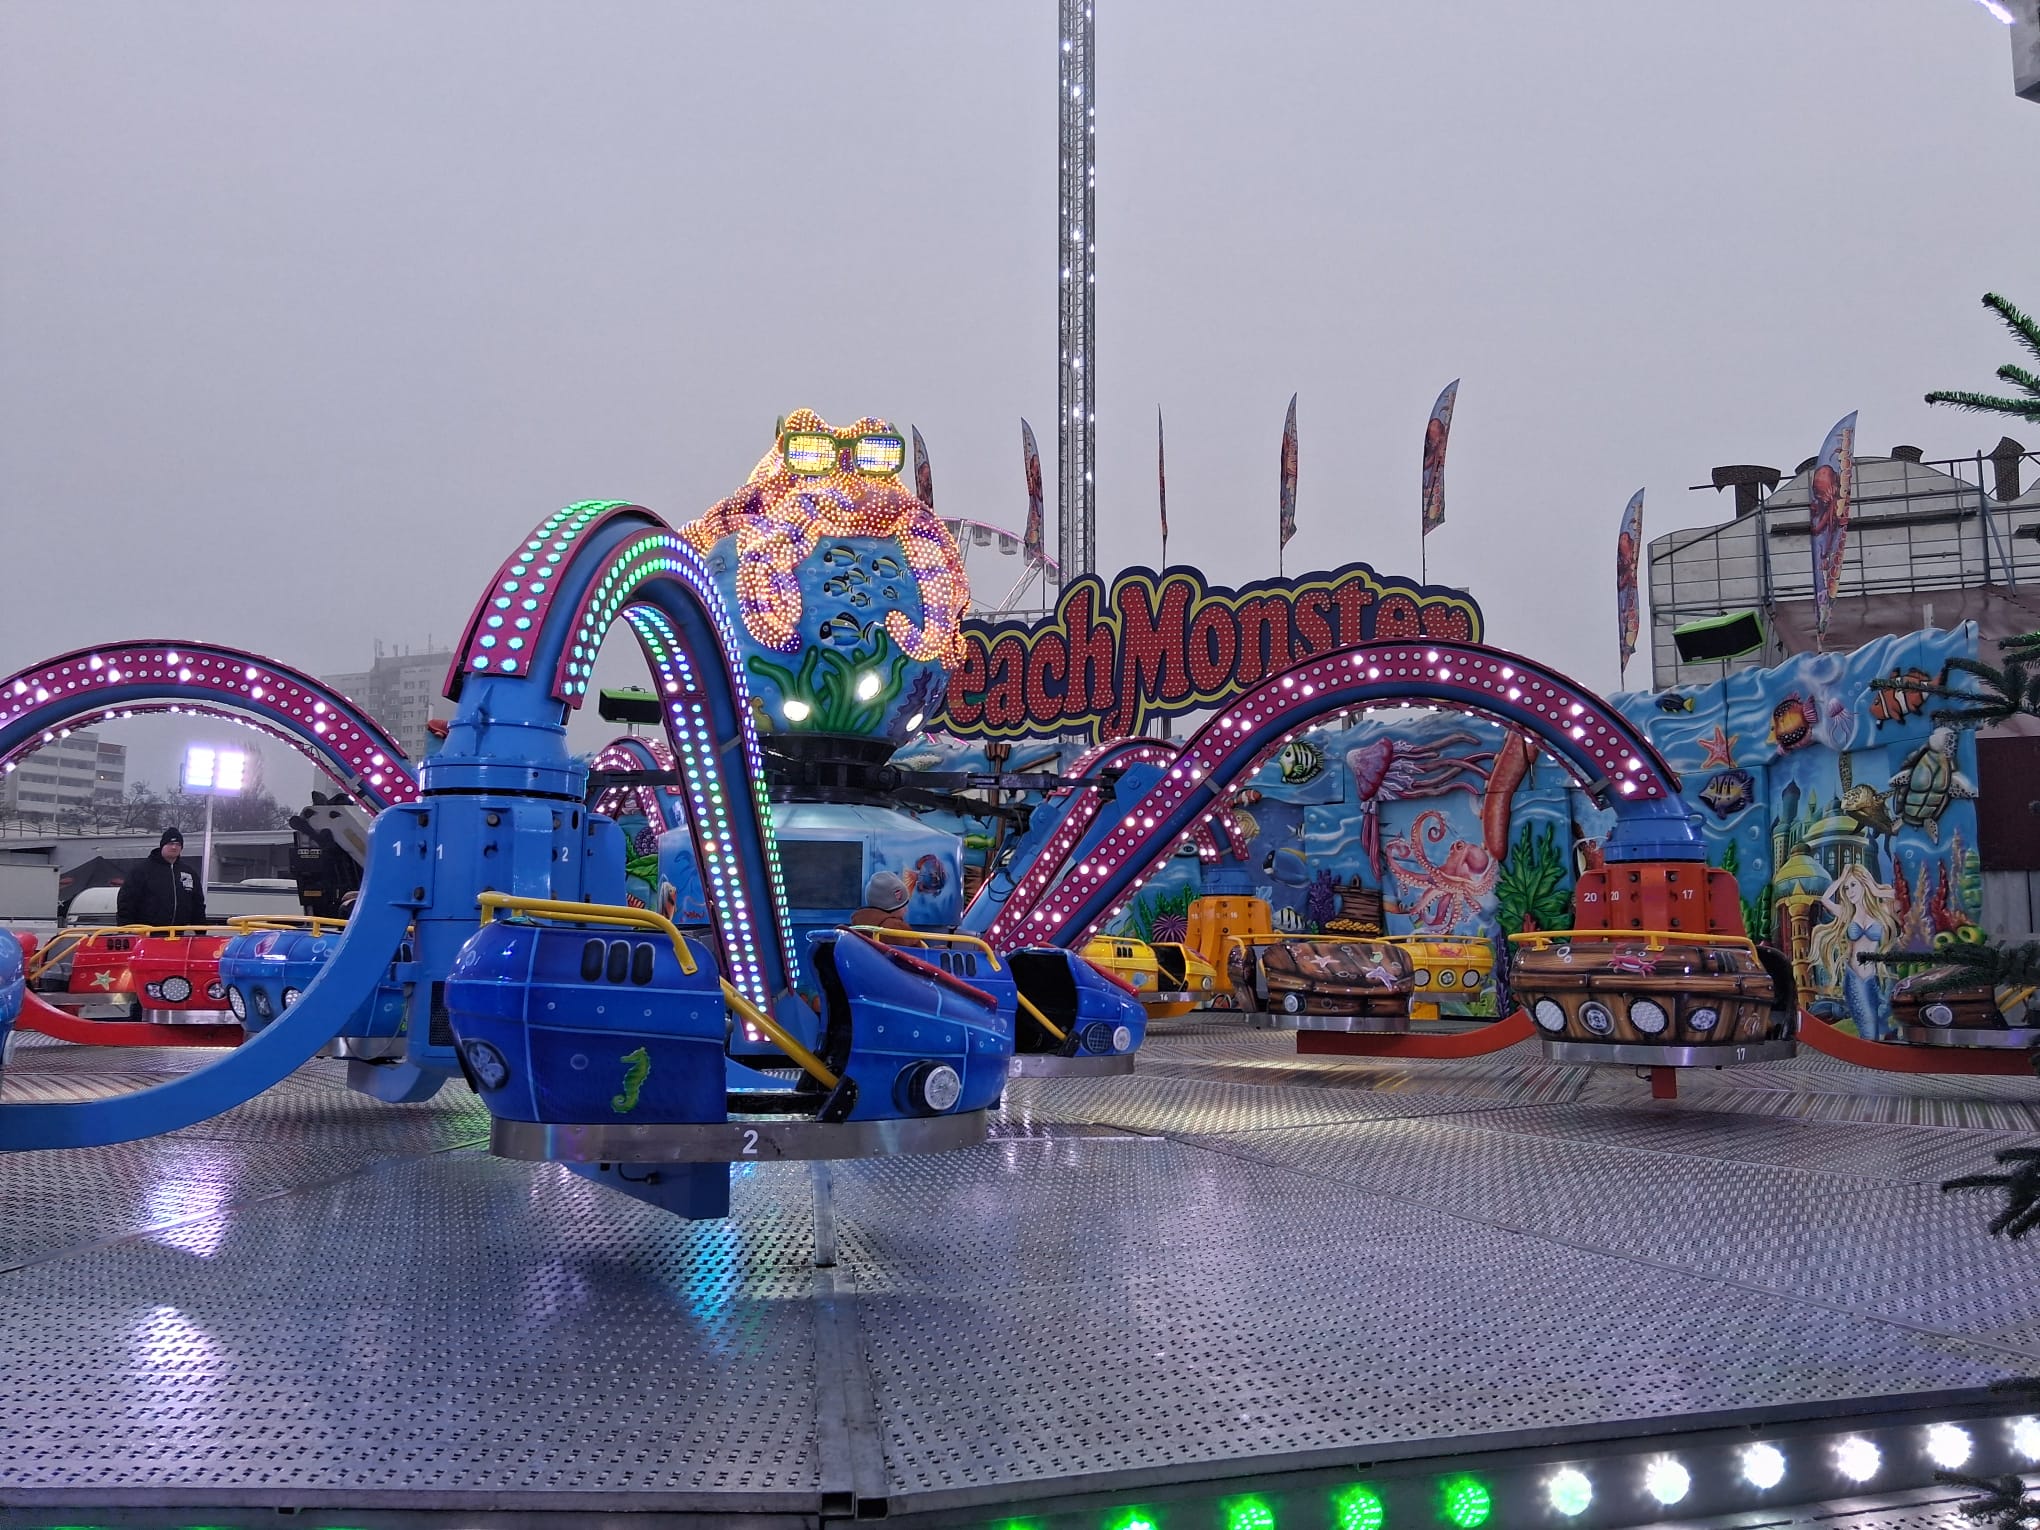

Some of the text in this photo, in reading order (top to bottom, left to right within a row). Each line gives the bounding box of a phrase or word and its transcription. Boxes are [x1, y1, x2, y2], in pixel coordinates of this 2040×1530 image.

[392, 840, 402, 857] 1
[436, 843, 444, 860] 1
[561, 846, 569, 862] 2
[1583, 892, 1598, 903] 20
[1610, 890, 1620, 901] 20
[1681, 889, 1694, 900] 17
[1159, 993, 1169, 1001] 16
[1736, 1047, 1746, 1061] 17
[1013, 1058, 1023, 1073] 3
[742, 1129, 759, 1154] 2
